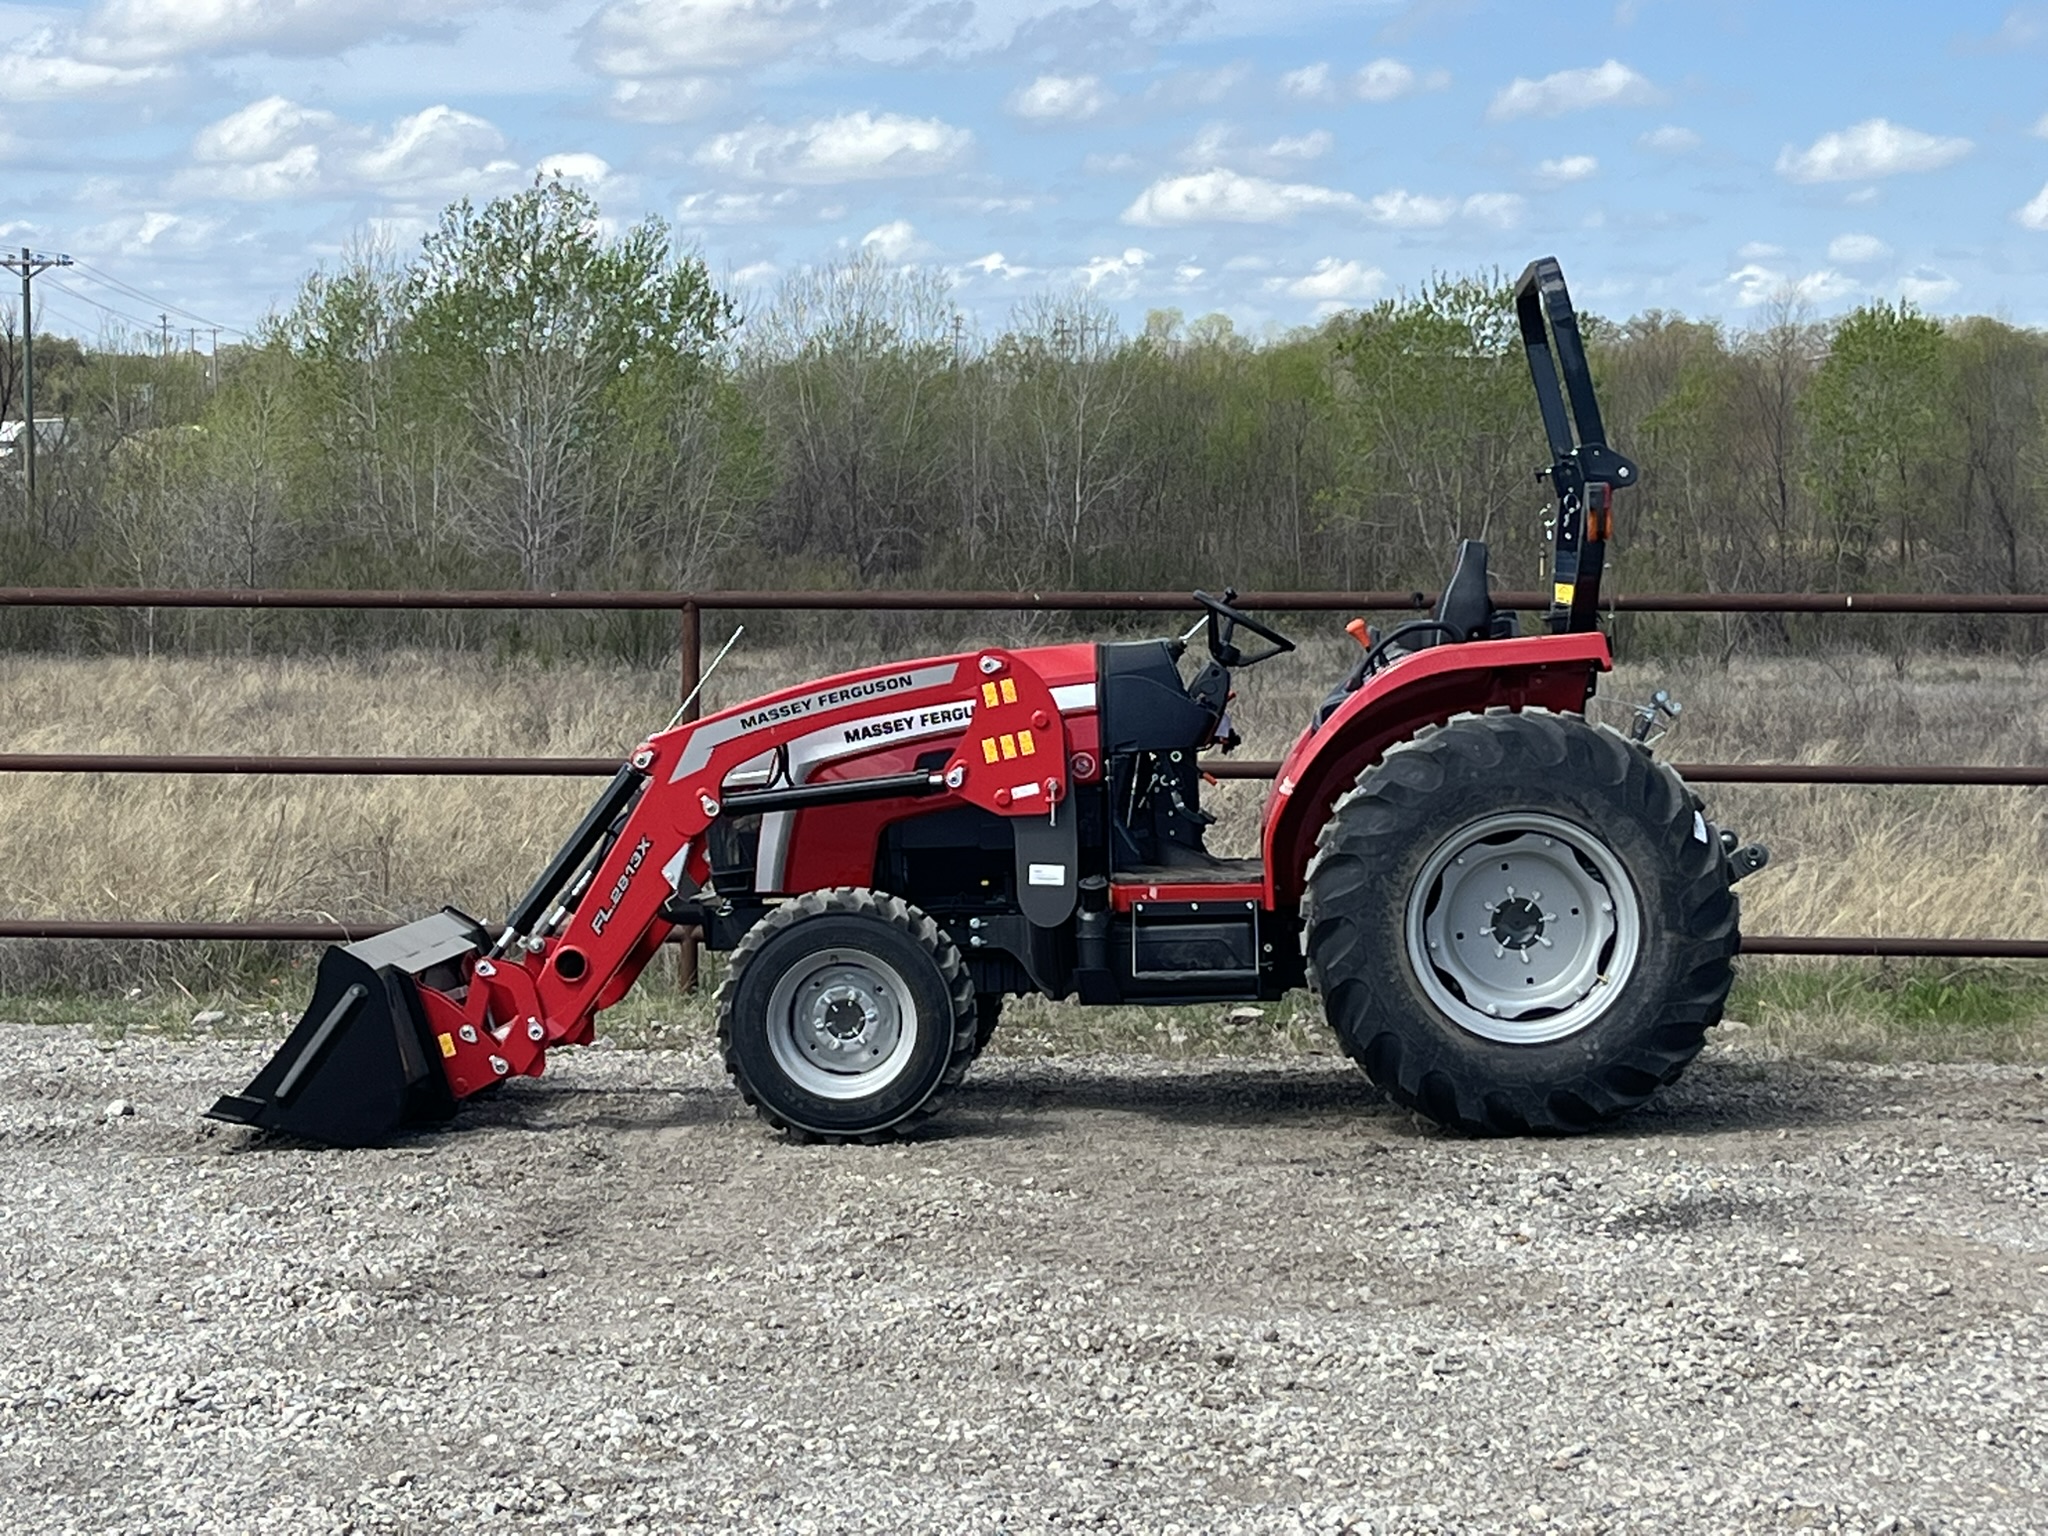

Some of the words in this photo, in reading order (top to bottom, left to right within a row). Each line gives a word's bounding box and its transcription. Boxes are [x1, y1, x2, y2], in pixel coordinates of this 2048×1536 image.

[740, 698, 811, 729] MASSEY
[818, 675, 912, 706] FERGUSON
[844, 716, 914, 743] MASSEY
